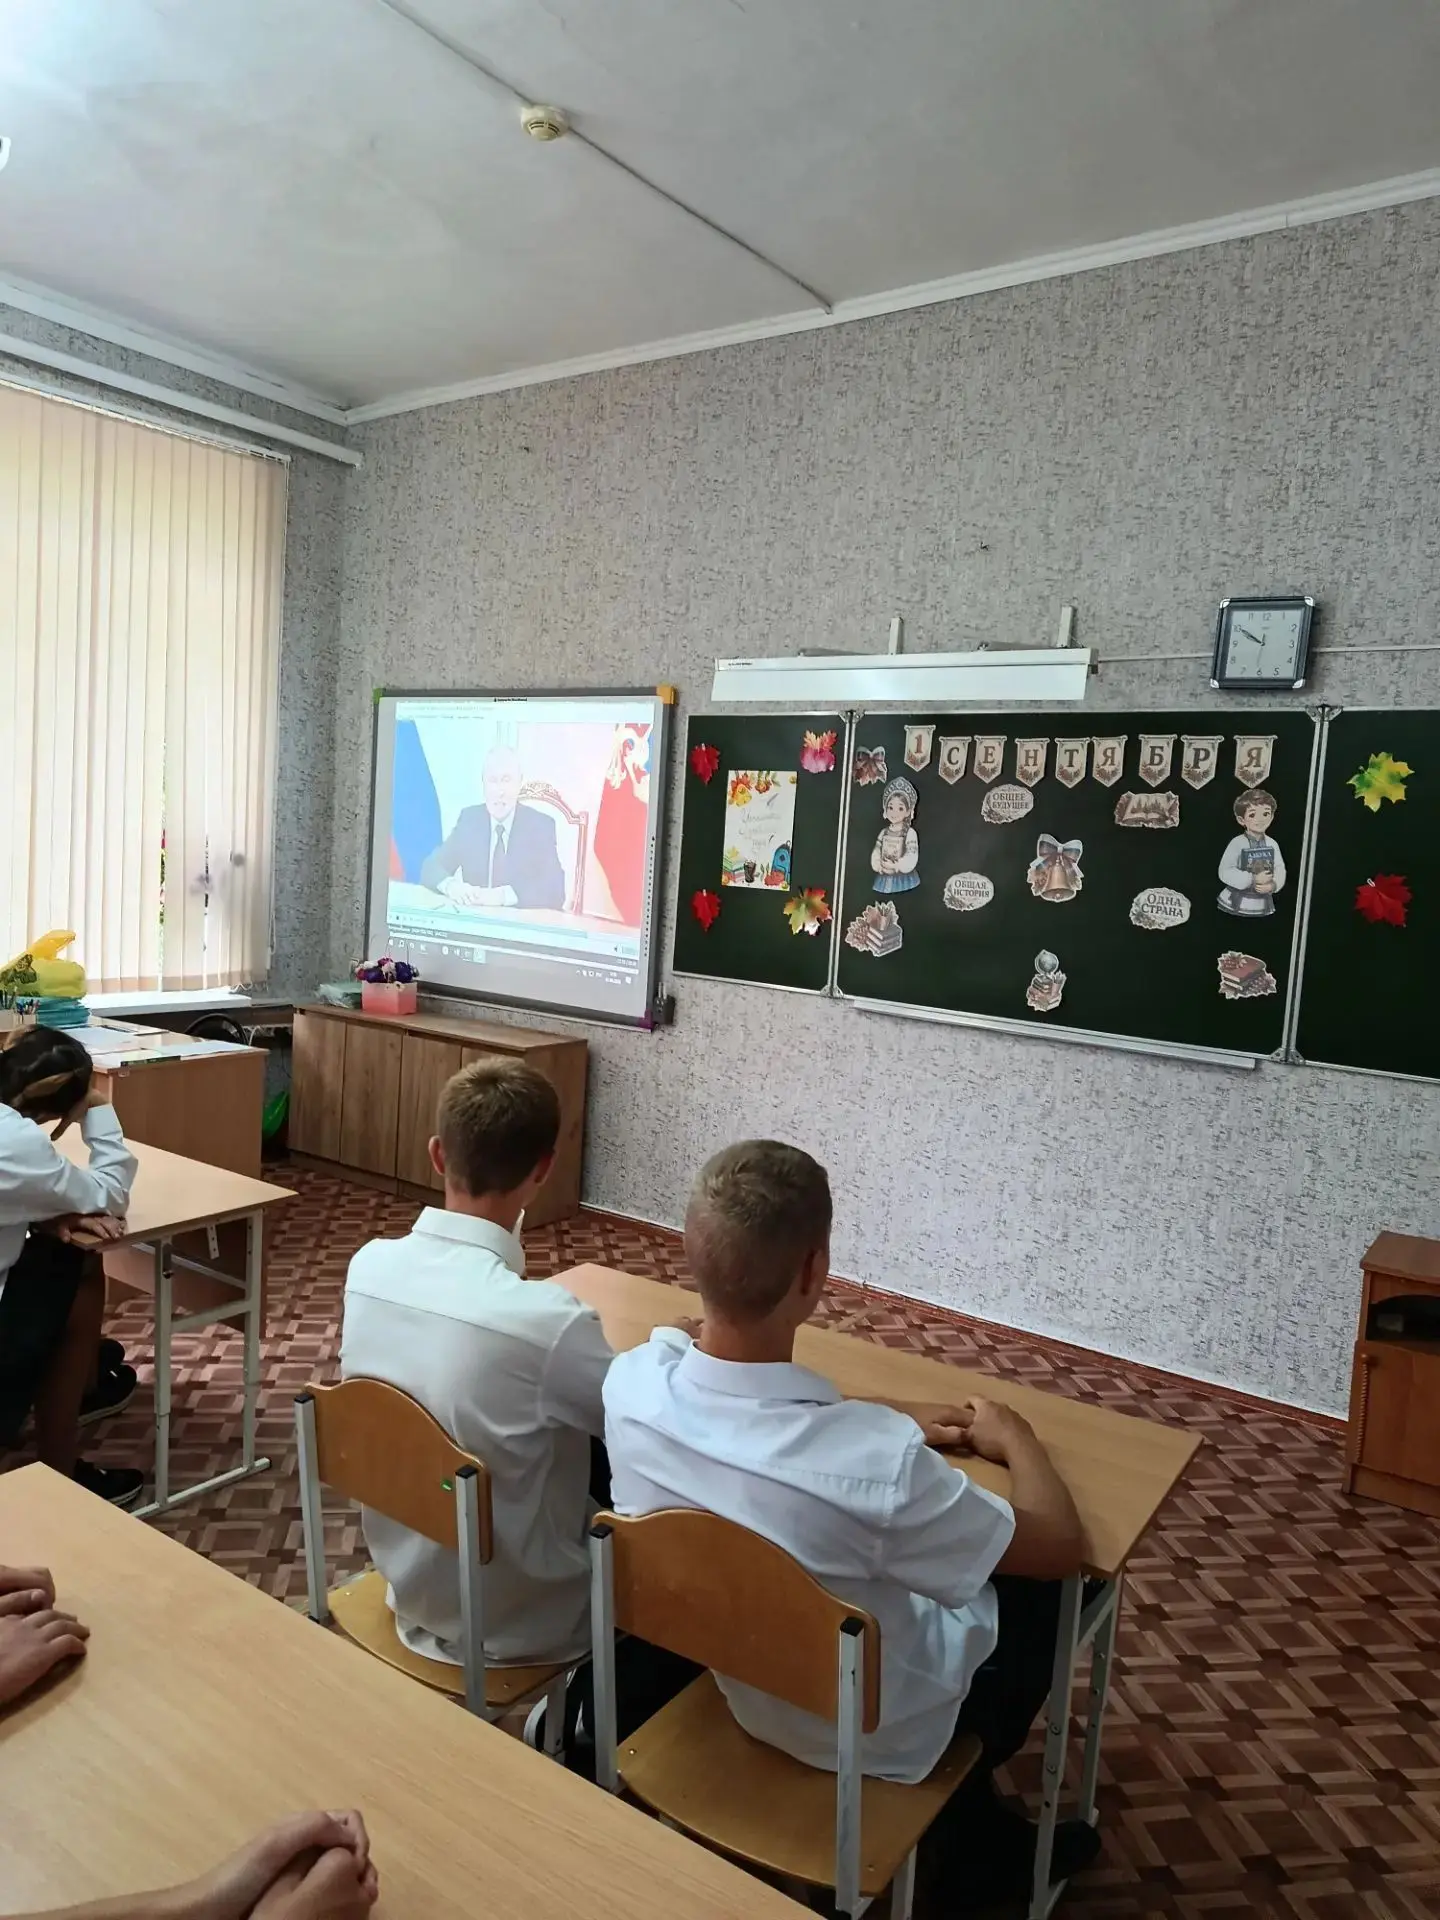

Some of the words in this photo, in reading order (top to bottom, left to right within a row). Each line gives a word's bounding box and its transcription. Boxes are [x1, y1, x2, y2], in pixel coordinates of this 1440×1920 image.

[1263, 612, 1271, 621] 12
[1291, 623, 1297, 632] 2
[1232, 640, 1238, 648] 9
[1289, 640, 1295, 648] 3
[1230, 656, 1236, 664] 8
[1287, 656, 1293, 664] 4
[1240, 667, 1246, 675] 7
[1256, 667, 1262, 676] 6
[1273, 667, 1279, 676] 5
[914, 734, 923, 754] 1
[992, 792, 1025, 801] ОБЩЕЕ
[992, 801, 1029, 810] БУДУЩЕЕ
[954, 880, 986, 889] ОБЩАЯ
[953, 889, 990, 898] ИСТОРИЯ
[1147, 893, 1181, 907] ОДНА
[1142, 903, 1184, 918] СТРАНА
